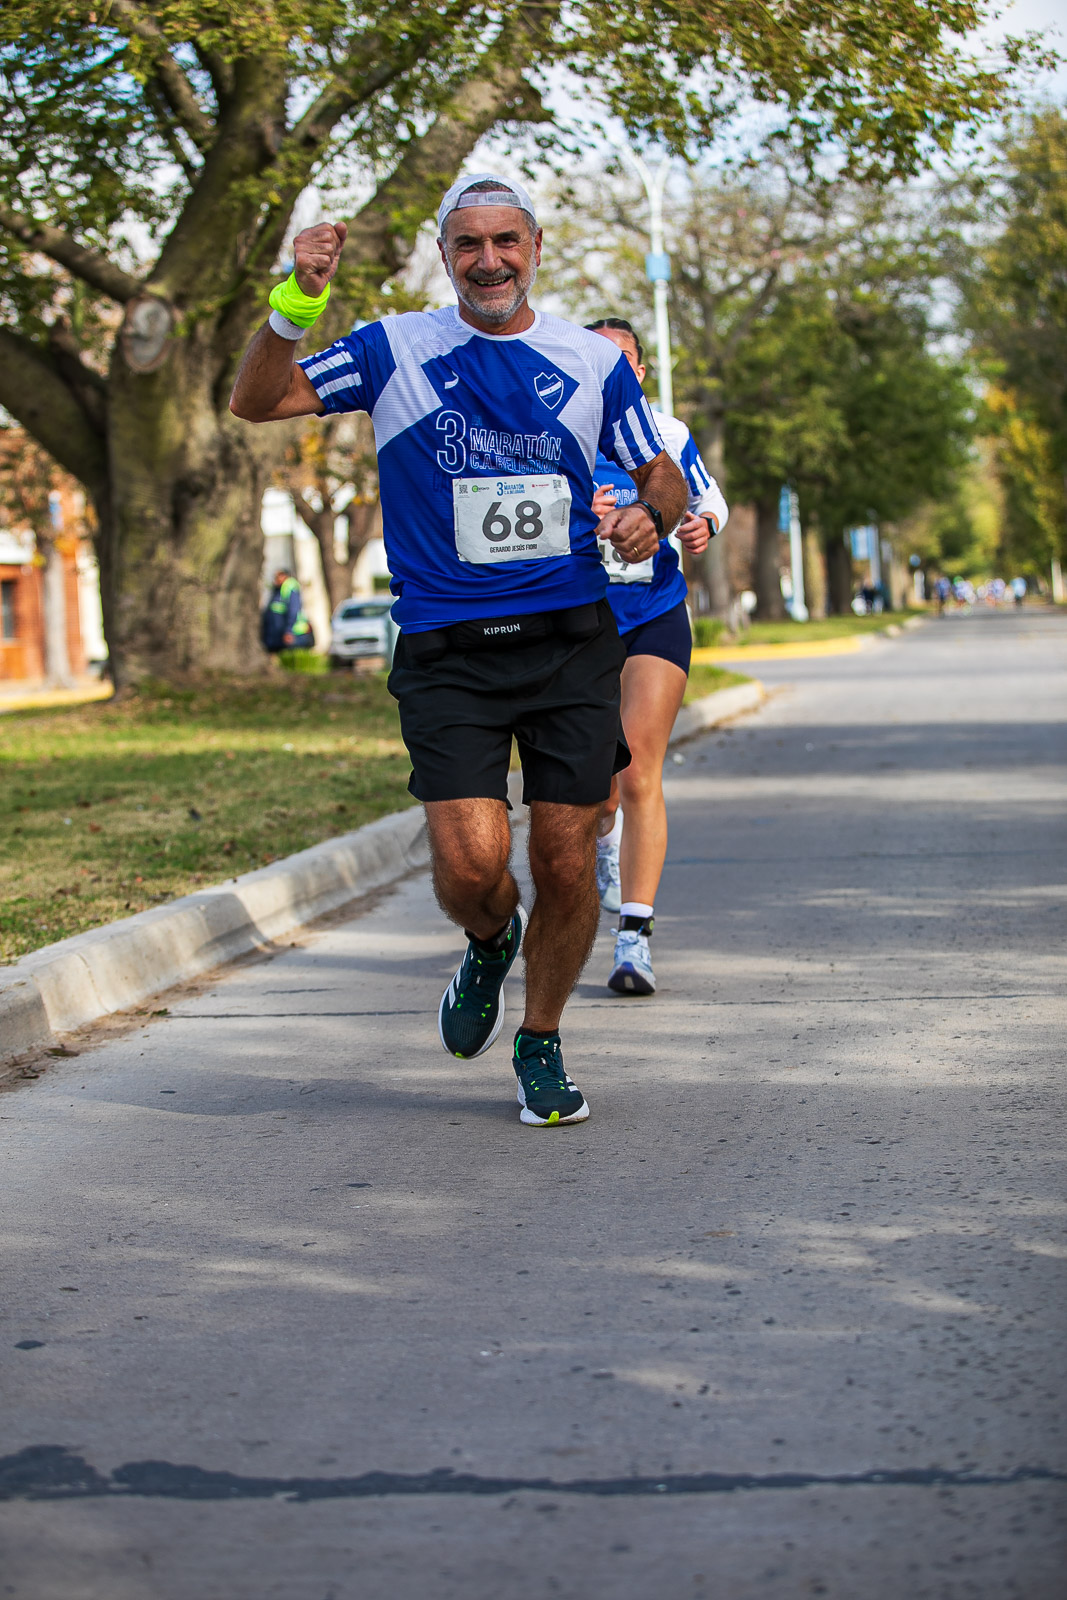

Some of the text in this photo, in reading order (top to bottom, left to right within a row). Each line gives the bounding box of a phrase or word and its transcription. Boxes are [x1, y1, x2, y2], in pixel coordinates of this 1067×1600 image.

[436, 410, 466, 474] 3
[470, 428, 562, 461] MARATÓN
[496, 481, 504, 496] 3
[482, 500, 544, 542] 68
[511, 544, 525, 552] JESÚS
[483, 623, 521, 635] KIPRUN
